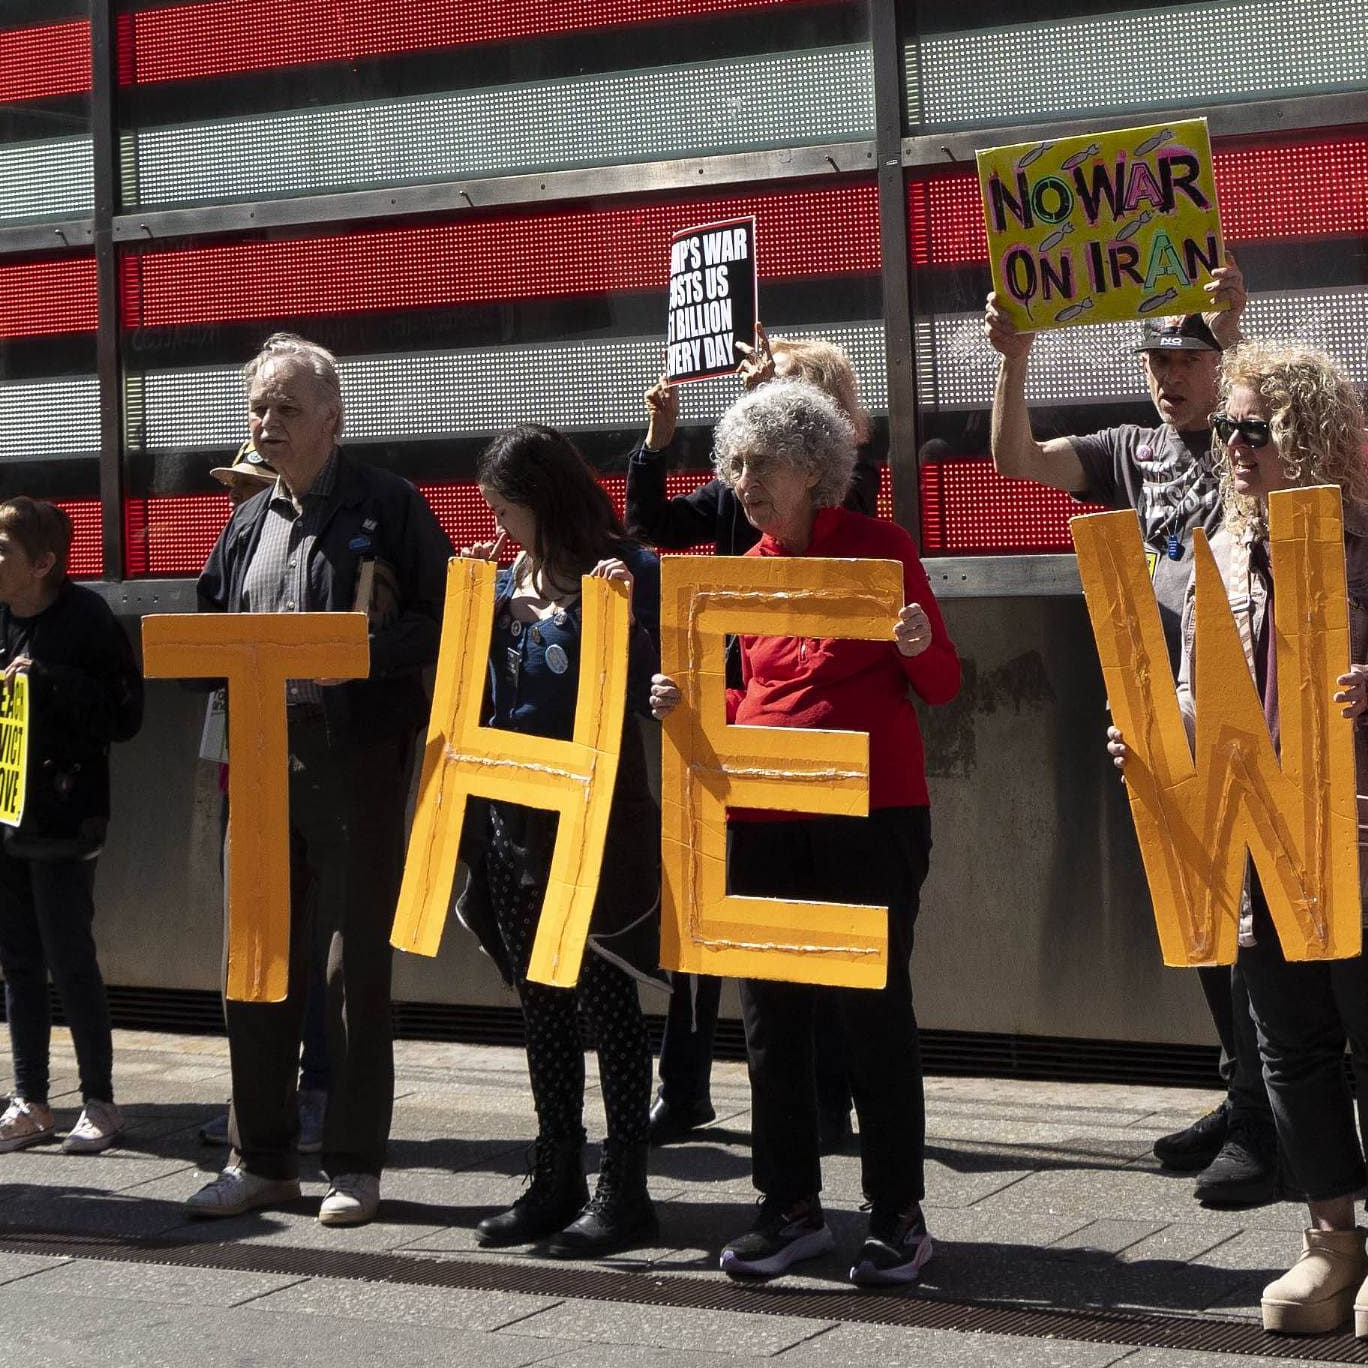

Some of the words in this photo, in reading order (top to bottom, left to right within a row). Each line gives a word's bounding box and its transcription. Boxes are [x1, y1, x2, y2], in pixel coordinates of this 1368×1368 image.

[703, 228, 748, 266] WAR
[705, 265, 729, 300] US
[1002, 243, 1076, 304] ON
[1086, 230, 1220, 294] IRAN
[676, 298, 733, 341] BILLION
[704, 333, 735, 369] DAY
[1160, 337, 1182, 346] NO
